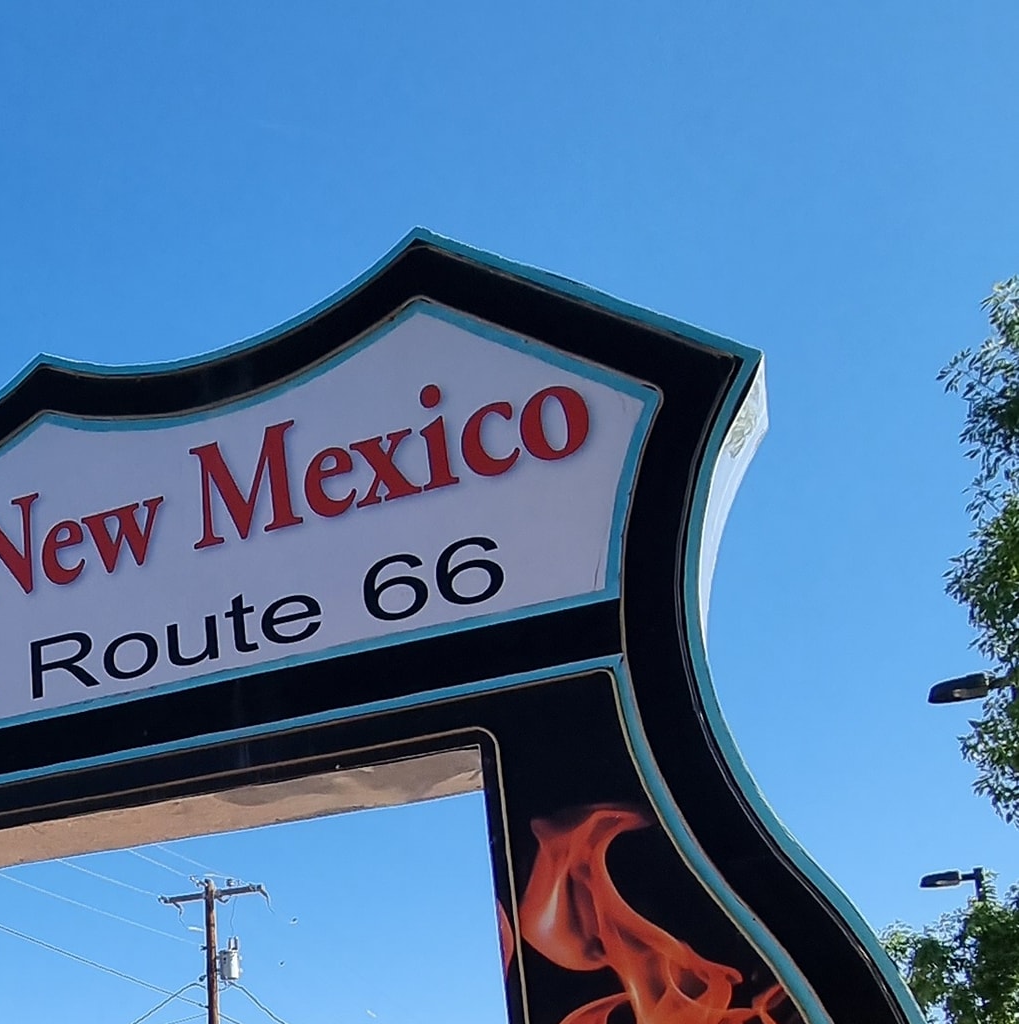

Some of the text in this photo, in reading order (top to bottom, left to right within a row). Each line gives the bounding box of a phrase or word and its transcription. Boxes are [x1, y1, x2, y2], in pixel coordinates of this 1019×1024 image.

[189, 383, 591, 549] Mexico
[30, 593, 323, 699] Route
[363, 536, 505, 621] 66
